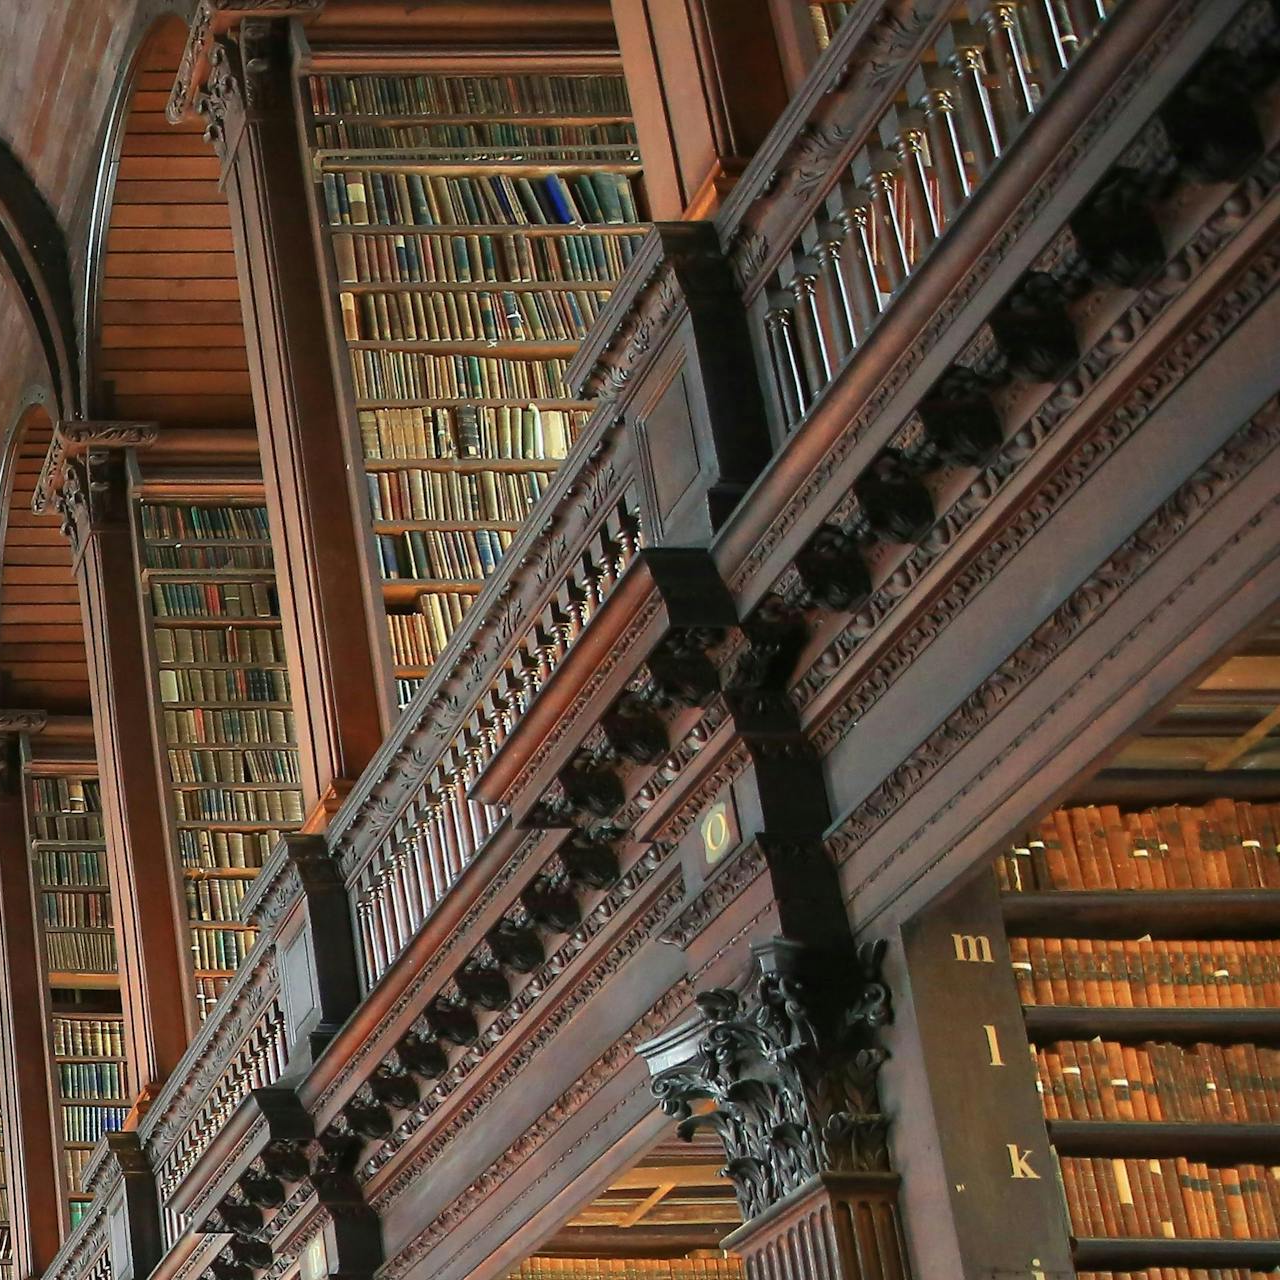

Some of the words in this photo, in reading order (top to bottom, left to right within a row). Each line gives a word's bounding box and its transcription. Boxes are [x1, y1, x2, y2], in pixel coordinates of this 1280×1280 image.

[952, 935, 994, 962] m
[984, 1025, 1004, 1065] l
[1007, 1144, 1040, 1178] k
